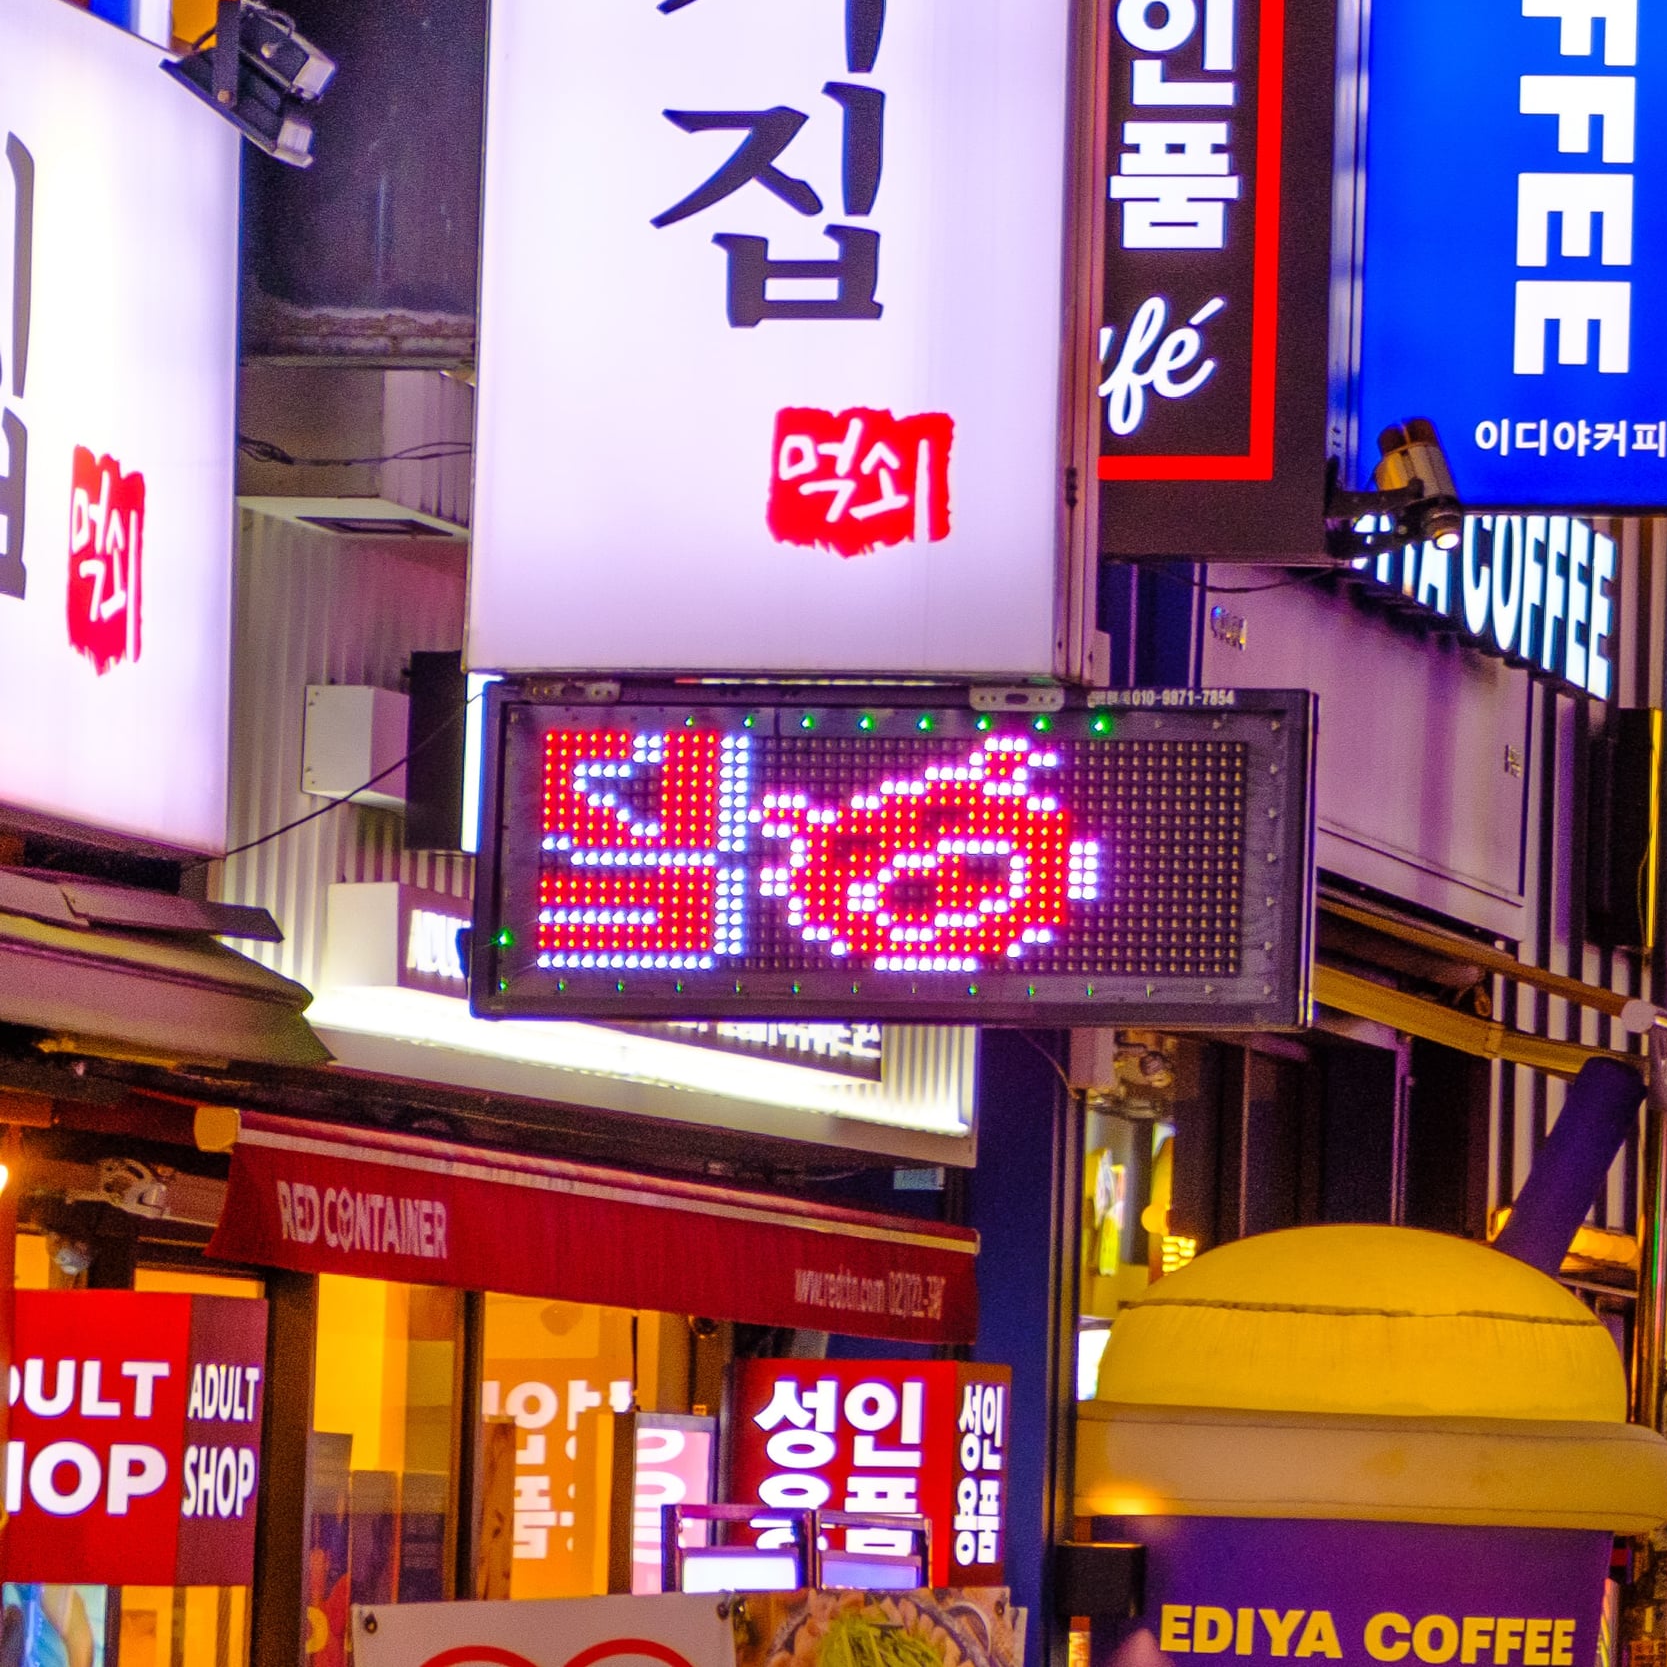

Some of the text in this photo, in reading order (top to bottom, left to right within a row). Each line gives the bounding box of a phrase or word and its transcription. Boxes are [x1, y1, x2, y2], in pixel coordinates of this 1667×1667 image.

[1474, 417, 1667, 459] 이디야커피
[1462, 515, 1616, 703] COFFEE
[277, 1181, 318, 1244] RED
[188, 1363, 261, 1421] ADULT
[753, 1376, 923, 1468] 성인
[957, 1383, 1004, 1473] 성인
[181, 1444, 256, 1518] SHOP
[955, 1477, 1003, 1568] 용품
[1159, 1605, 1576, 1667] EDIYA COFFEE
